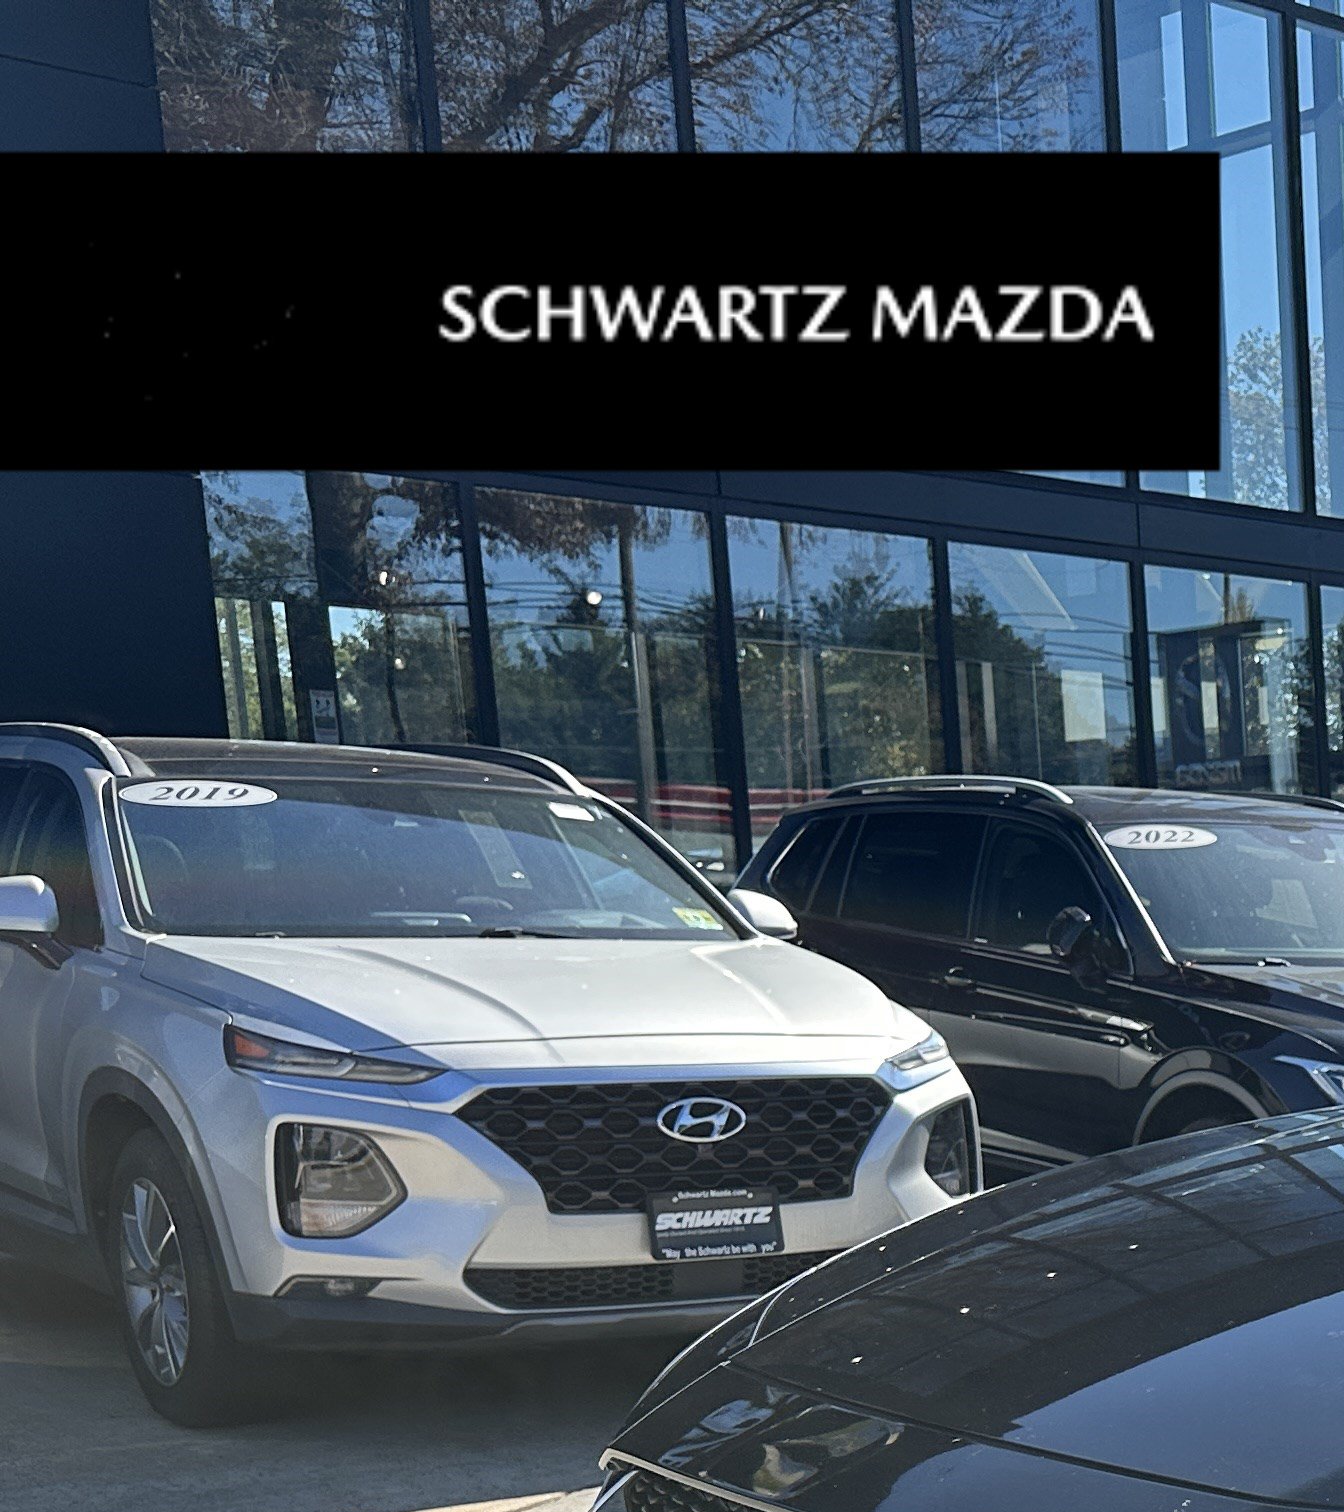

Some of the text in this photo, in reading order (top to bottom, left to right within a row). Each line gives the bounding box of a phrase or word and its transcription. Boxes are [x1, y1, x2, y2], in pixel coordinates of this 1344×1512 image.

[148, 786, 250, 801] 2019
[1127, 830, 1195, 845] 2022
[655, 1206, 773, 1231] SCHWARTZ
